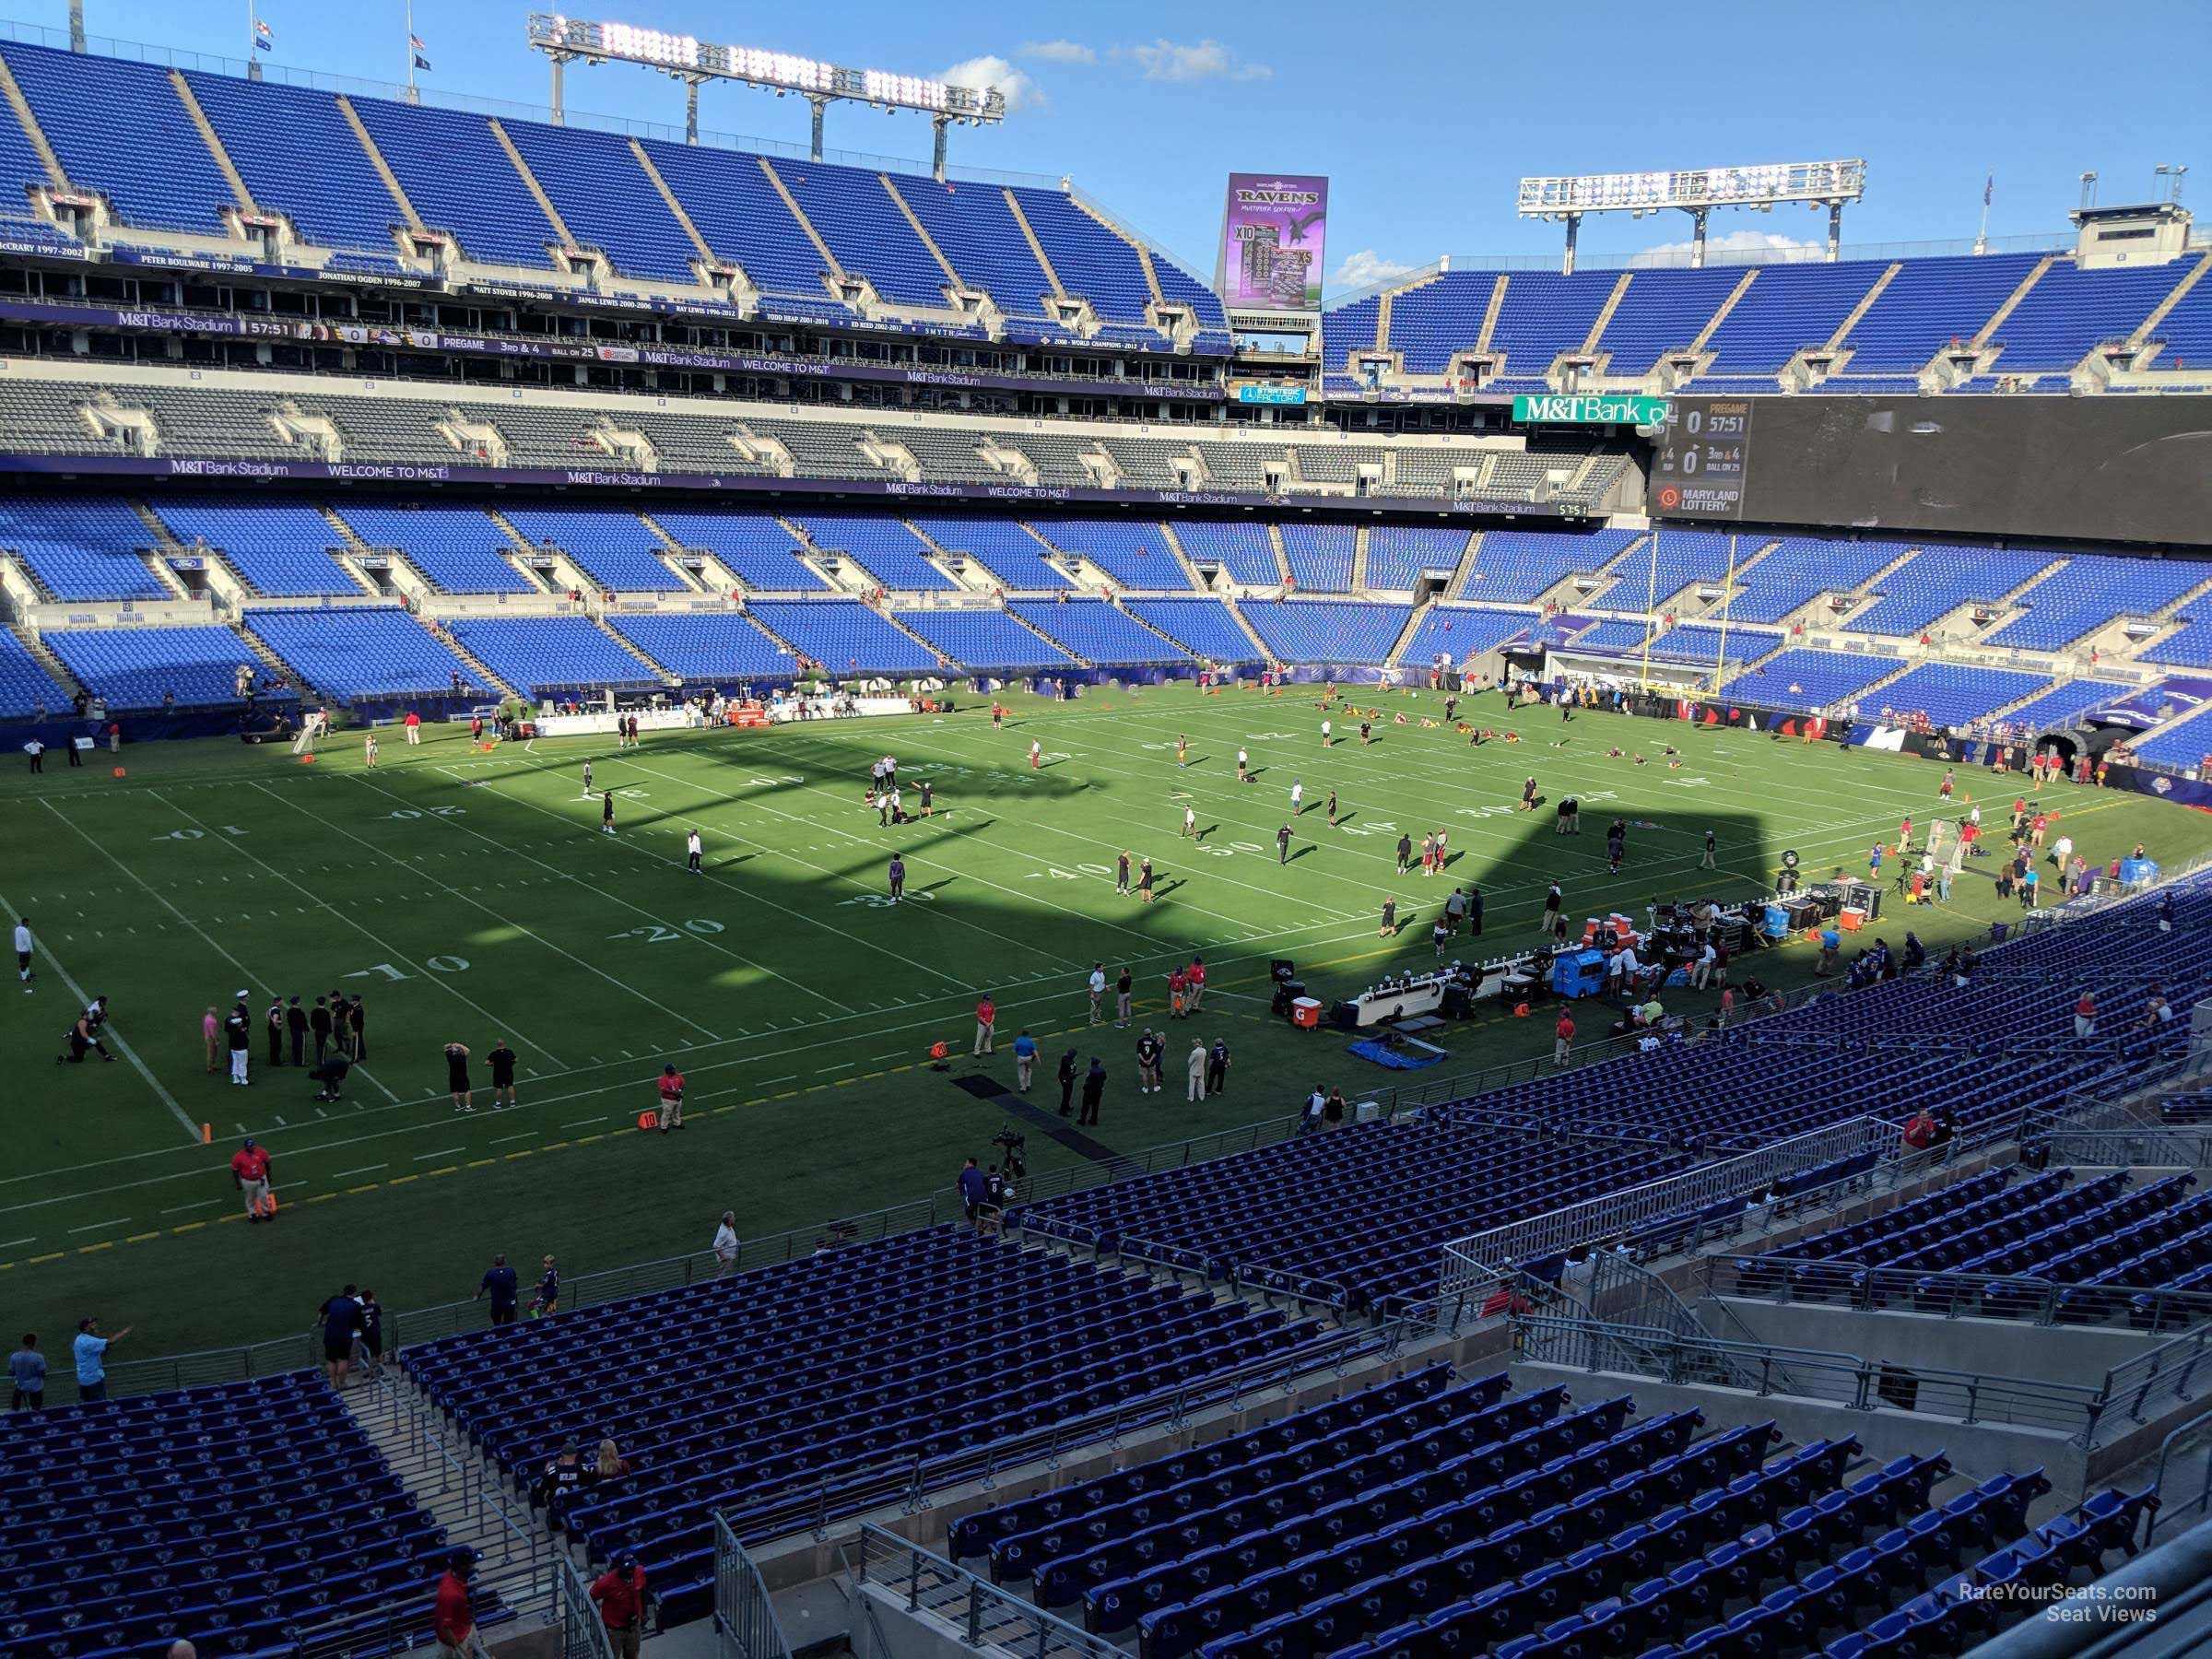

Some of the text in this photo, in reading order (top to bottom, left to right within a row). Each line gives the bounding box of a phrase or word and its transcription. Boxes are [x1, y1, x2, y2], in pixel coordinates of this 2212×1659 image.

[1236, 190, 1319, 205] RAVENS
[1236, 226, 1254, 240] X10
[37, 245, 83, 257] 1997-2002
[141, 255, 253, 273] PETER BOULWARE 1997-2005
[319, 271, 421, 288] JONATHAN OGDEN 1996-2007
[474, 286, 553, 300] MATT STOVER 1996-2008
[578, 297, 599, 305] JAMAL
[599, 299, 618, 307] LEWIS
[688, 306, 705, 314] LEWIS
[118, 312, 232, 333] M&T Bank Stadium
[251, 324, 288, 335] 57:51
[925, 328, 953, 336] SMYTH
[444, 337, 485, 350] PREGAME
[533, 345, 540, 354] 4
[581, 347, 594, 357] 25
[645, 351, 671, 363] M&T
[671, 354, 691, 366] Bank
[693, 356, 730, 368] Stadium
[742, 359, 830, 374] WELCOME TO M&T
[907, 371, 981, 386] M&T Bank Stadium
[1145, 386, 1218, 399] M&T Bank Stadium
[1257, 387, 1300, 395] STRATEGIC
[1526, 396, 1583, 420] M&T
[1585, 397, 1641, 421] Bank
[1710, 404, 1748, 414] PREGAME
[1688, 411, 1701, 434] 0
[1709, 417, 1744, 432] 57:51
[1733, 447, 1740, 460] 4
[171, 460, 288, 476] M&T Bank Stadium
[1683, 452, 1697, 474] 0
[1707, 463, 1721, 472] BALL
[328, 465, 394, 477] WELCOME
[396, 467, 415, 477] TO
[568, 472, 660, 485] M&T Bank Stadium
[886, 483, 962, 496] M&T Bank Stadium
[988, 488, 1032, 497] WELCOME
[1034, 488, 1047, 498] TO
[1683, 489, 1739, 501] MARYLAND
[1159, 492, 1237, 503] M&T Bank Stadium
[1453, 501, 1535, 513] M&T Bank Stadium
[1559, 505, 1587, 514] 57:51
[1681, 500, 1727, 512] LOTTERY
[1049, 863, 1112, 880] 40
[641, 919, 725, 943] 20
[371, 955, 470, 982] 10
[1296, 1008, 1305, 1021] G
[936, 1043, 946, 1056] 20
[1145, 1046, 1150, 1054] 9
[645, 1113, 656, 1127] 10
[992, 1183, 997, 1193] 8
[365, 1314, 372, 1327] 5
